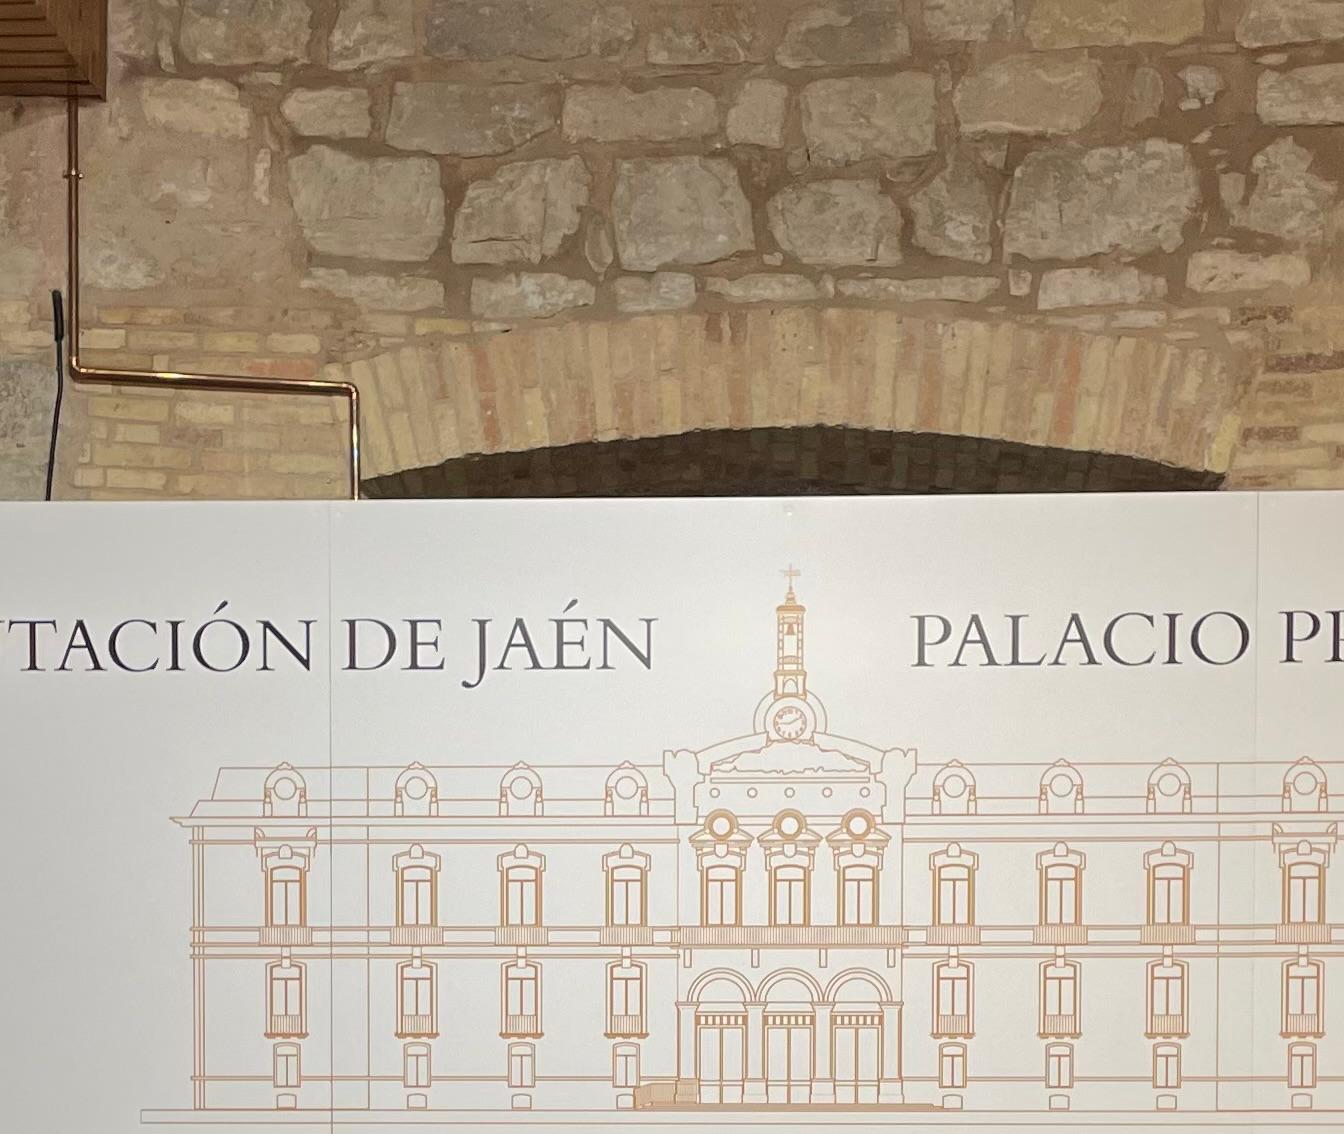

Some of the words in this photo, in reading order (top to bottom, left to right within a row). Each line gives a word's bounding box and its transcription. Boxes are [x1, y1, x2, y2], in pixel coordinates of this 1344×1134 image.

[341, 619, 445, 670] DE
[462, 599, 658, 688] JAÉN
[911, 612, 1249, 666] PALACIO
